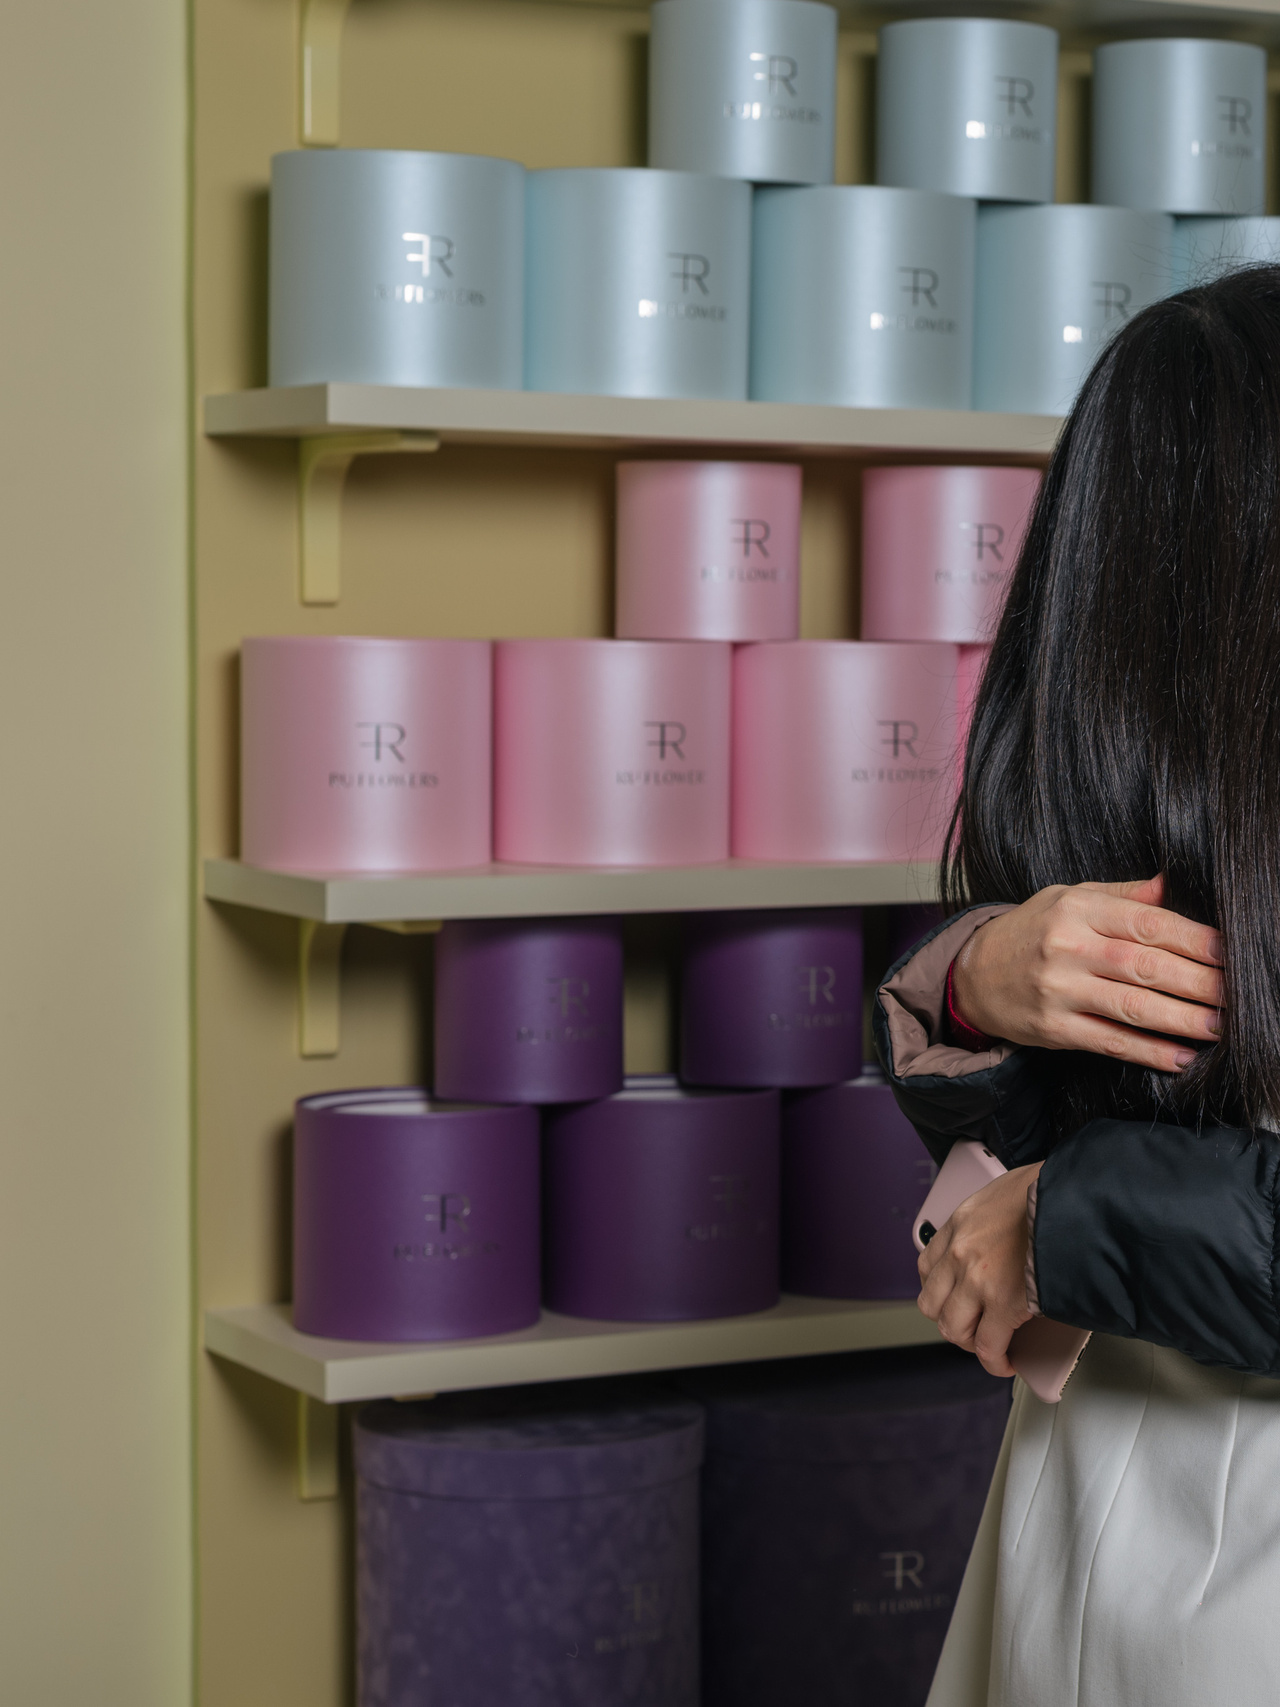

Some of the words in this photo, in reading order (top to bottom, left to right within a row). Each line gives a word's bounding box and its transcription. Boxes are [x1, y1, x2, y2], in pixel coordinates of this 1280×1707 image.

[355, 721, 407, 763] FR
[643, 720, 687, 761] FR
[877, 720, 919, 759] FR
